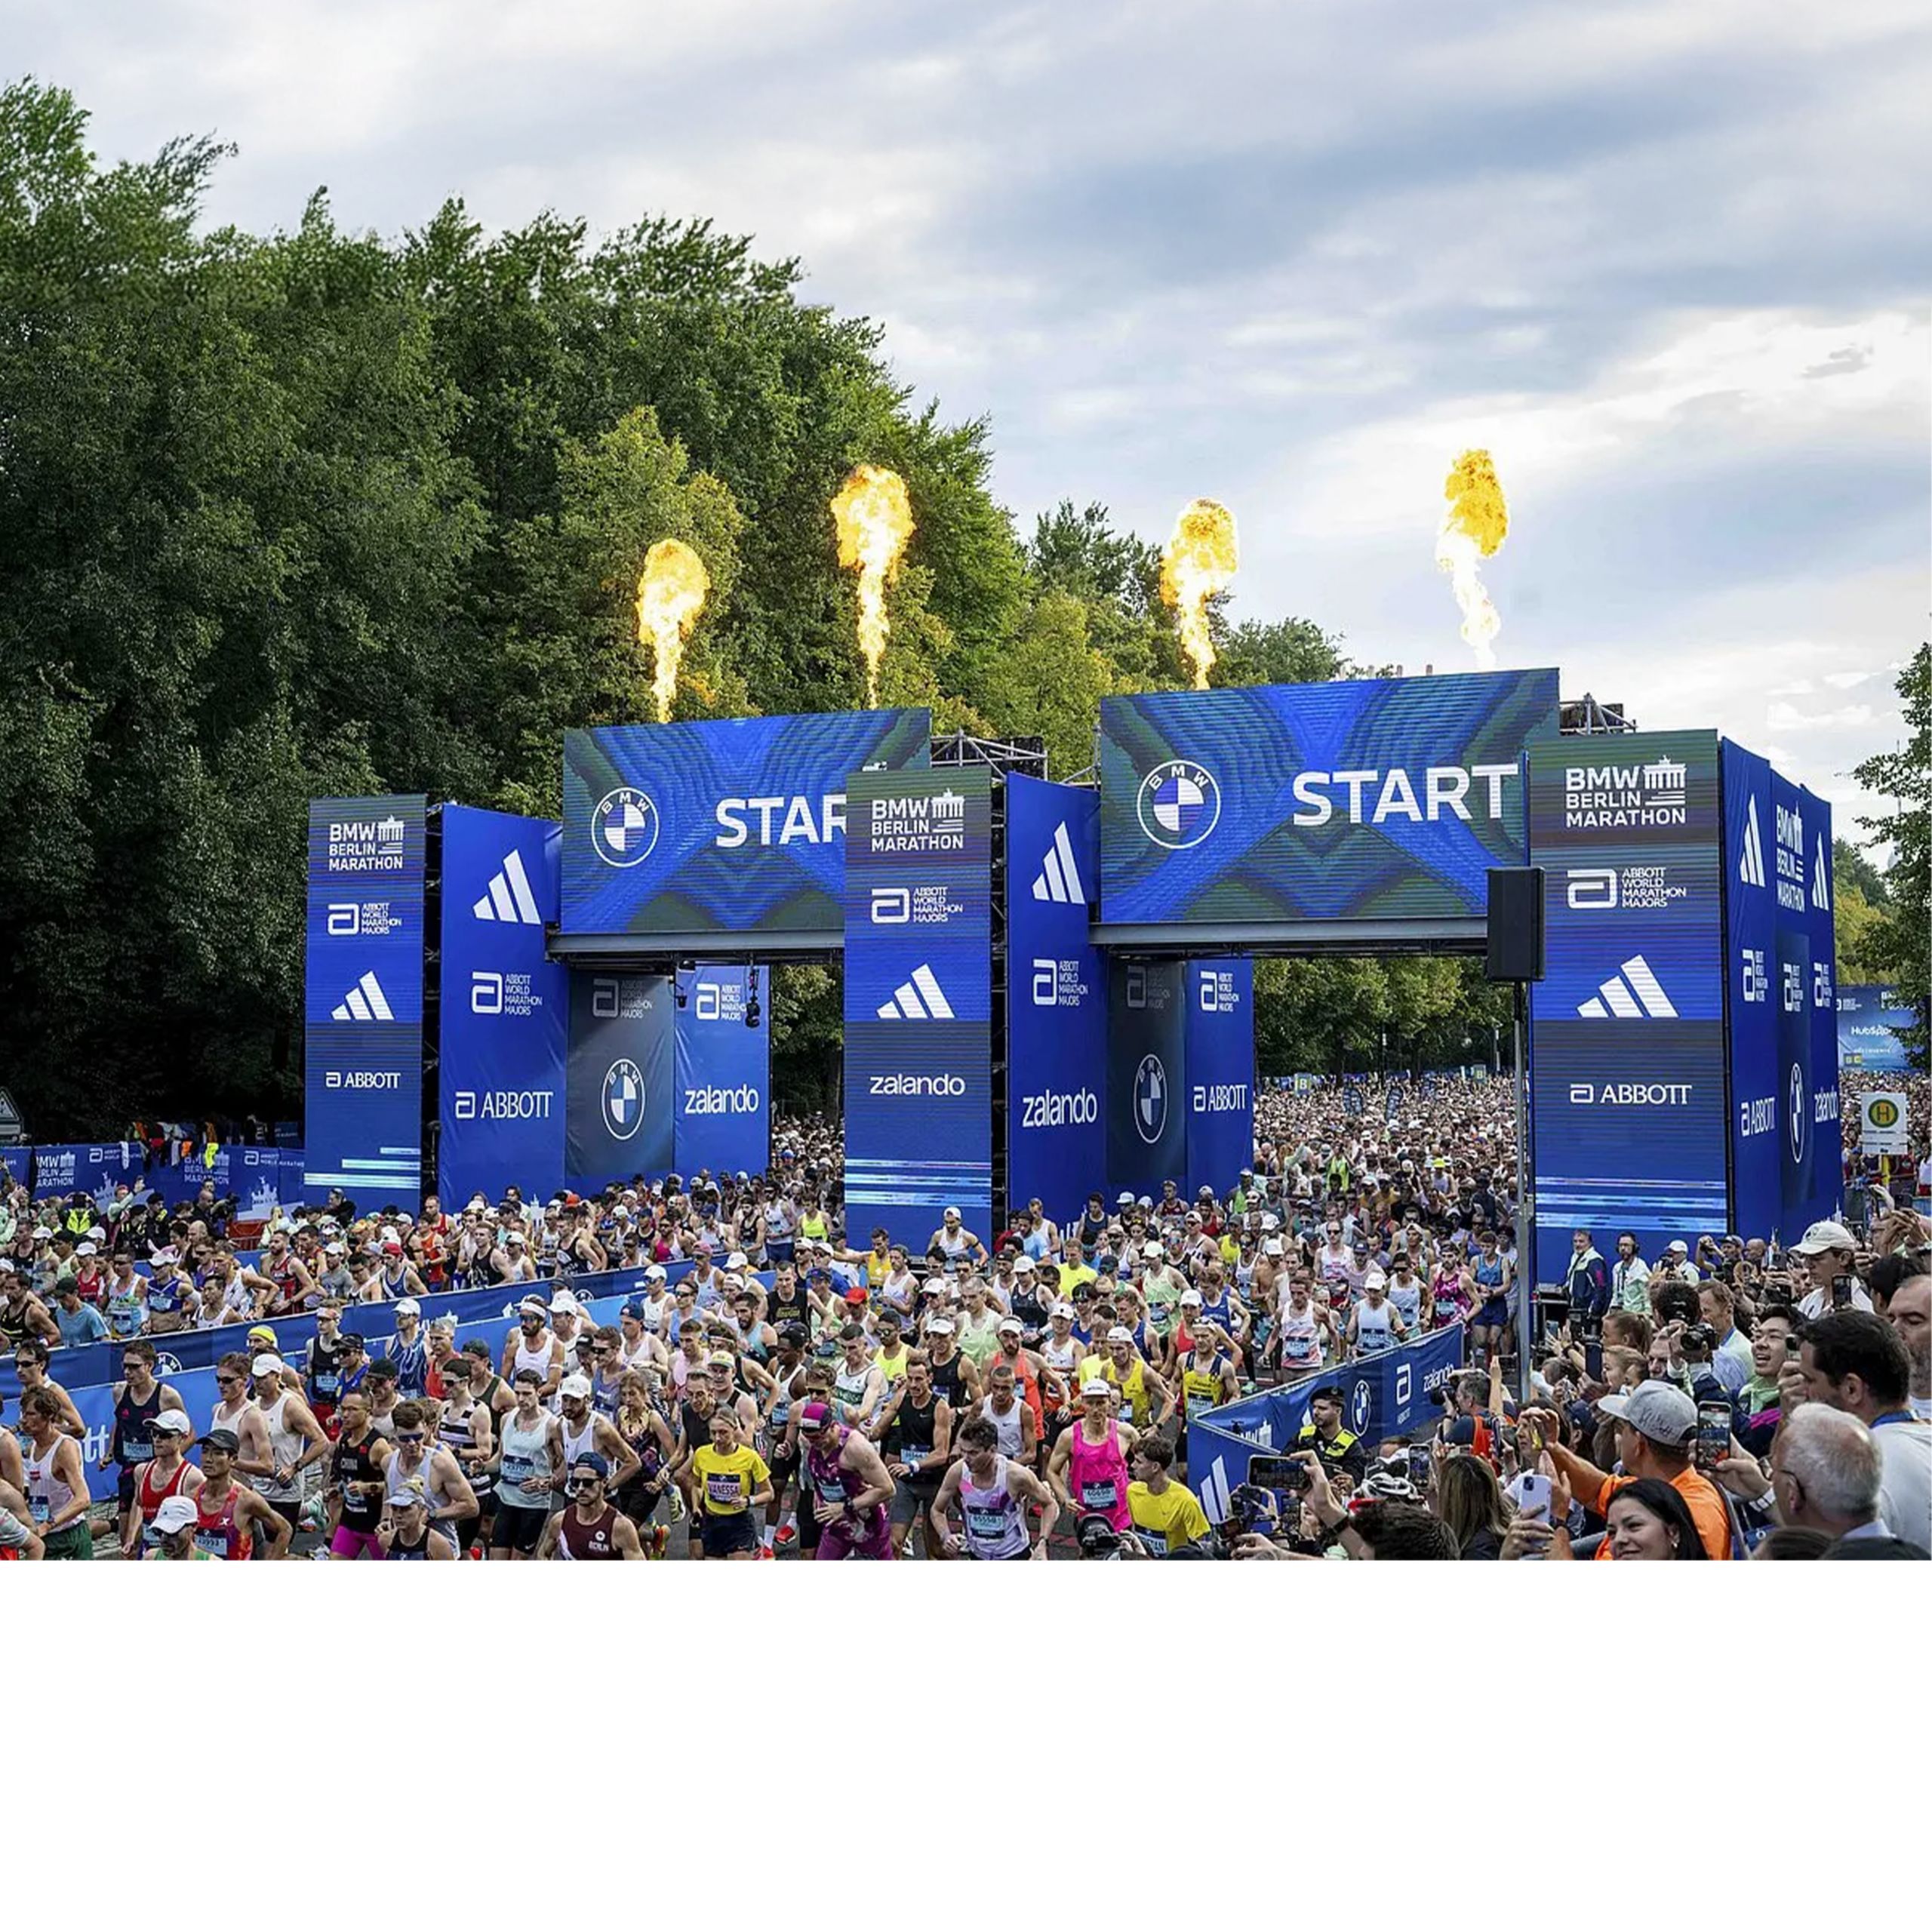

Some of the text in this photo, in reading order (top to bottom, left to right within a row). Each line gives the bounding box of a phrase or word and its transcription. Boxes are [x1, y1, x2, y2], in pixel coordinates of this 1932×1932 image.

[1148, 764, 1208, 791] BMW
[1565, 766, 1640, 792] BMW
[601, 792, 649, 814] BMW
[1292, 764, 1518, 827] START
[1565, 791, 1641, 809] BERLIN
[872, 797, 929, 820] BMW
[715, 794, 847, 848] STAR
[1566, 808, 1686, 828] MARATHON
[330, 823, 376, 841] BMW
[872, 819, 929, 835] BERLIN
[329, 842, 376, 856] BERLIN
[872, 835, 964, 852] MARATHON
[328, 856, 403, 871] MARATHON
[1623, 867, 1666, 878] ABBOTT
[1622, 878, 1663, 888] WORLD
[913, 887, 948, 896] ABBOTT
[1622, 887, 1687, 897] MARATHON
[913, 896, 946, 905] WORLD
[1622, 897, 1667, 907] MAJORS
[913, 904, 963, 914] MARATHON
[913, 913, 948, 923] MAJORS
[505, 974, 531, 985] ABBOTT
[505, 985, 530, 995] WORLD
[504, 995, 543, 1006] MARATHON
[721, 1003, 747, 1012] MARATHO
[504, 1005, 531, 1016] MAJORS
[1851, 1025, 1891, 1035] HubSpo
[344, 1072, 401, 1088] ABBOTT
[870, 1073, 965, 1095] zalando
[685, 1084, 759, 1114] zalando
[1208, 1084, 1247, 1112] ABBOTT
[1600, 1084, 1692, 1104] ABBOTT
[481, 1091, 553, 1118] ABBOTT
[1023, 1088, 1097, 1127] zalando
[1877, 1106, 1890, 1121] H
[708, 1483, 738, 1495] VANESSA
